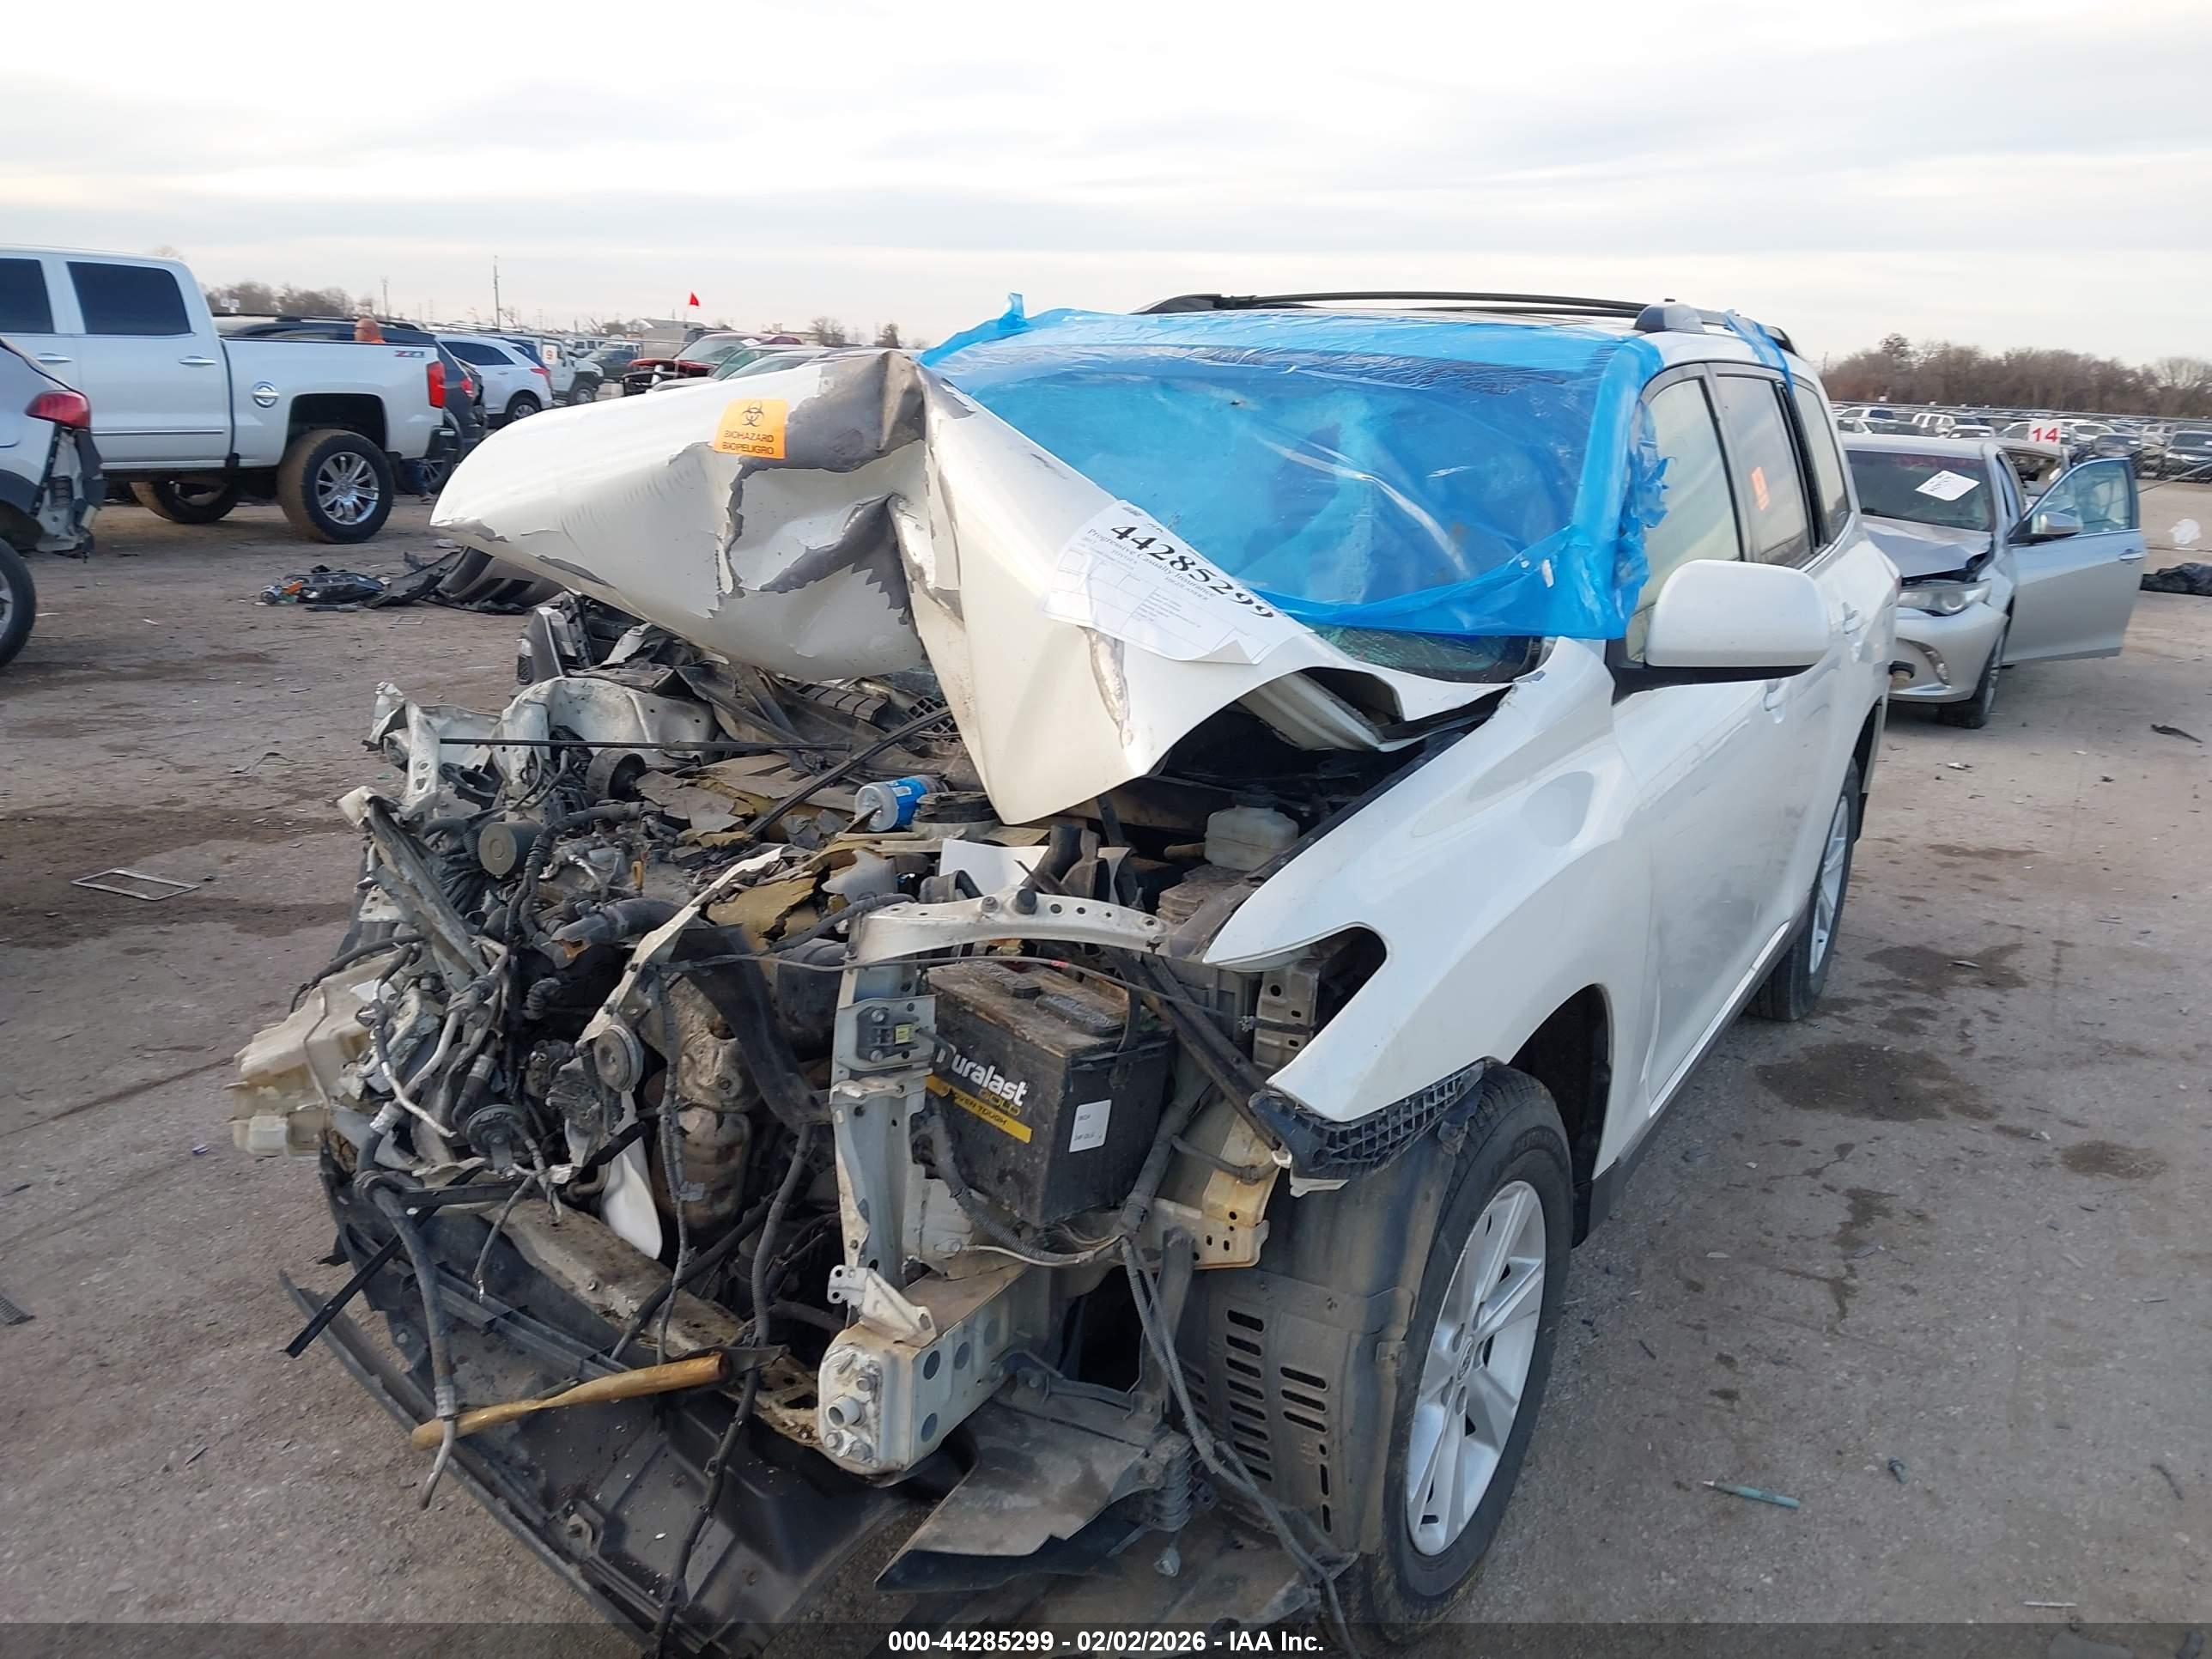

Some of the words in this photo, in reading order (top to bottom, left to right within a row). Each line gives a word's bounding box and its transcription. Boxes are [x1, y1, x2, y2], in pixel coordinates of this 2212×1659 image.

[724, 430, 775, 442] BIOHAZARD
[2033, 428, 2057, 441] 14
[722, 442, 775, 455] BIOPELIGRO
[1087, 528, 1136, 555] Progressive
[1137, 554, 1172, 575] Casualty
[1175, 573, 1216, 597] Insurance
[1110, 526, 1273, 618] 44285299
[979, 1088, 1021, 1116] GOLD
[977, 1105, 1008, 1126] TOUGH
